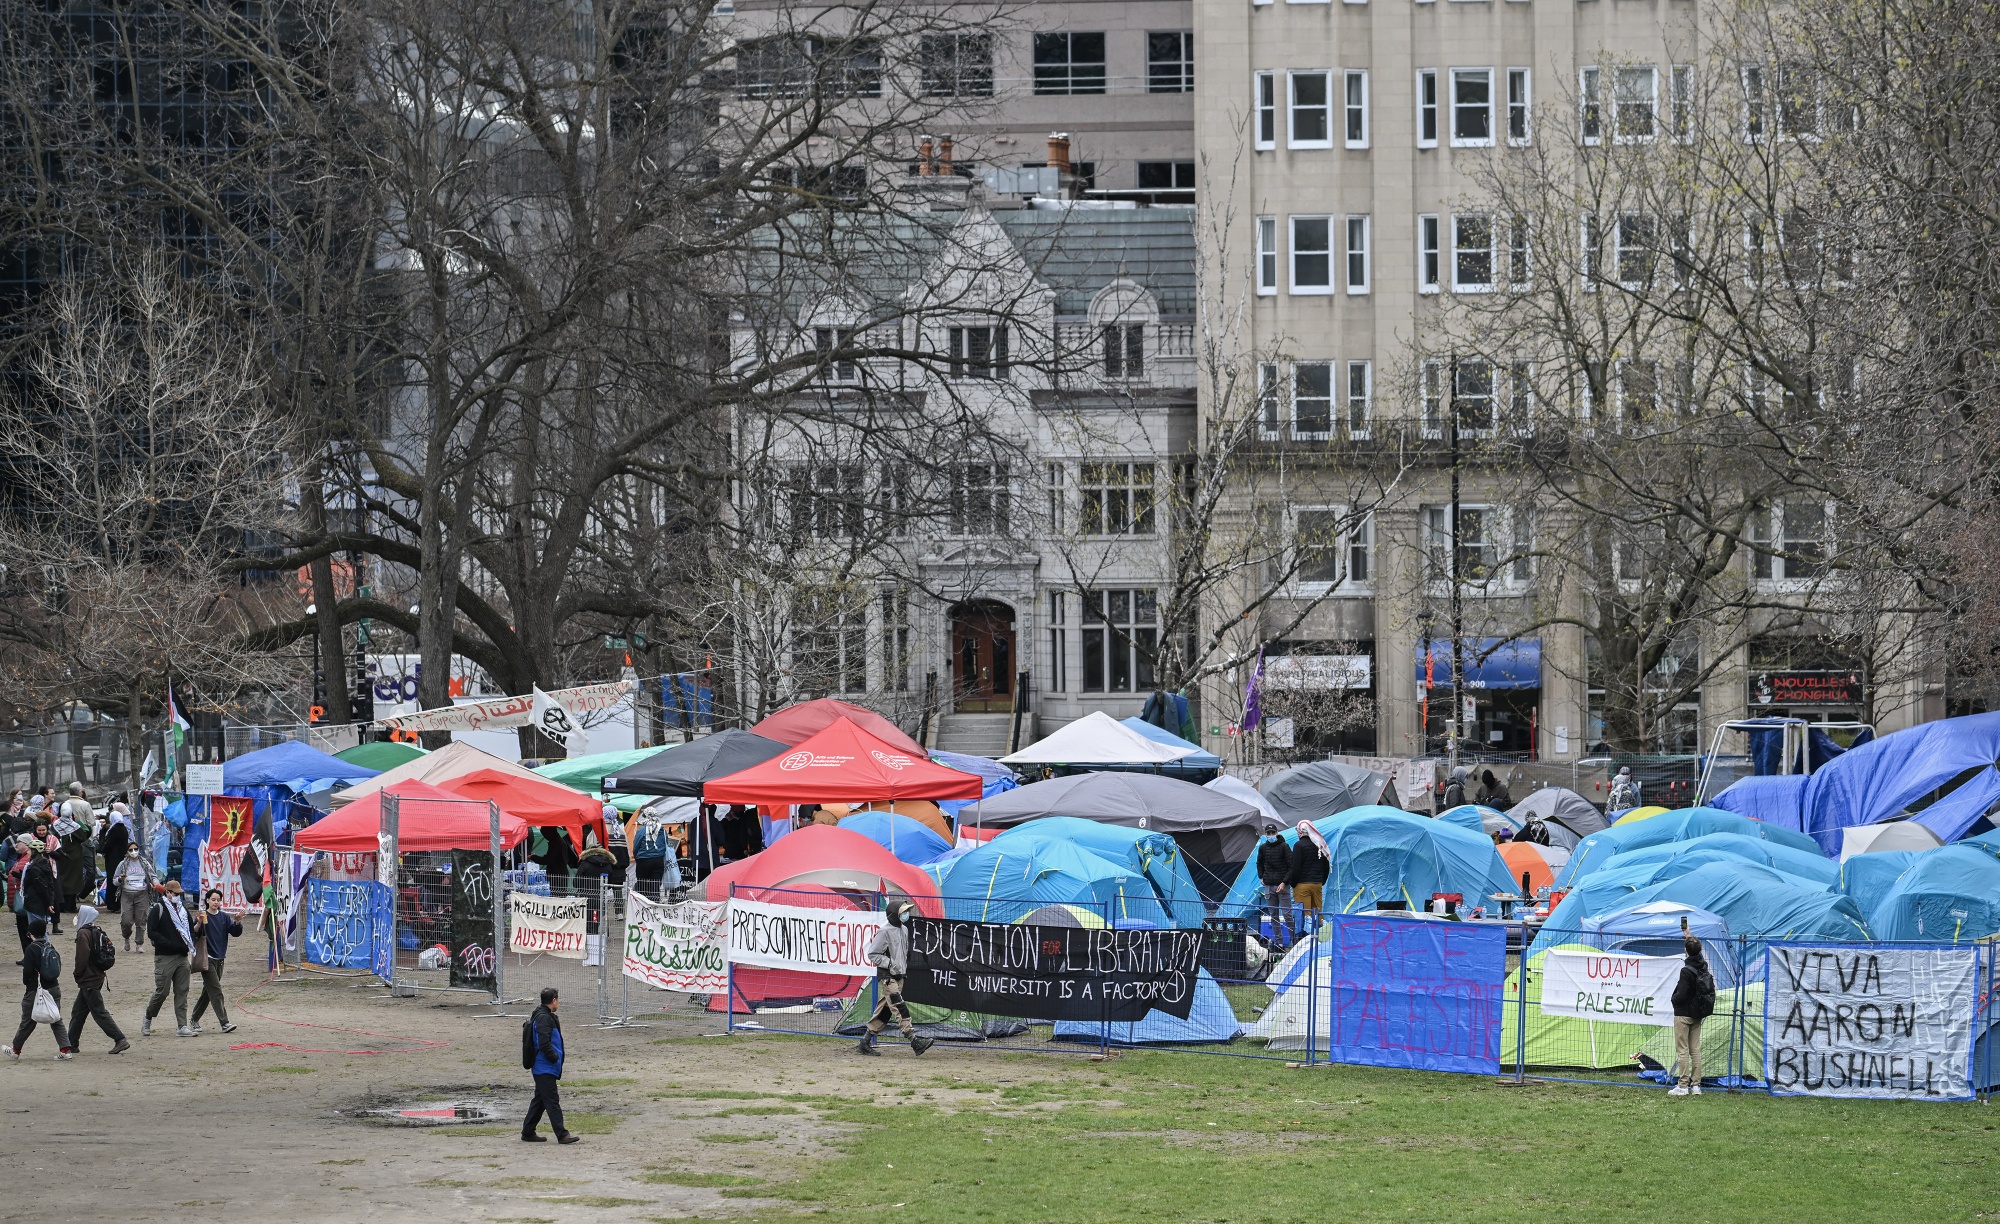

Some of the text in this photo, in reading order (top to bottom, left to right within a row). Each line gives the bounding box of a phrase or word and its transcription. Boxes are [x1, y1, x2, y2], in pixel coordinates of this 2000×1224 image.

[1774, 677, 1848, 688] NOUILLES
[1775, 690, 1848, 700] ZHONGHUA
[310, 882, 332, 914] WE
[338, 882, 371, 920] CARRY
[550, 902, 586, 920] AGAINST
[310, 912, 367, 948] WORLD
[515, 926, 582, 952] AUSTERITY
[661, 923, 691, 940] POUR LA
[912, 917, 1204, 974] EDUCATION FOR LIBERATION
[321, 942, 353, 967] OUR
[625, 923, 723, 971] Palestine
[1341, 920, 1478, 984] FREE
[1587, 956, 1640, 979] UQAM
[1782, 949, 1882, 996] VIVA
[931, 969, 1165, 1000] THE UNIVERSITY IS A FACTORY
[1601, 982, 1613, 990] pour
[1576, 991, 1655, 1017] PALESTINE
[1336, 980, 1504, 1061] PALESTINE
[1781, 1000, 1916, 1047] AARON
[1773, 1047, 1941, 1096] BUSHNELL
